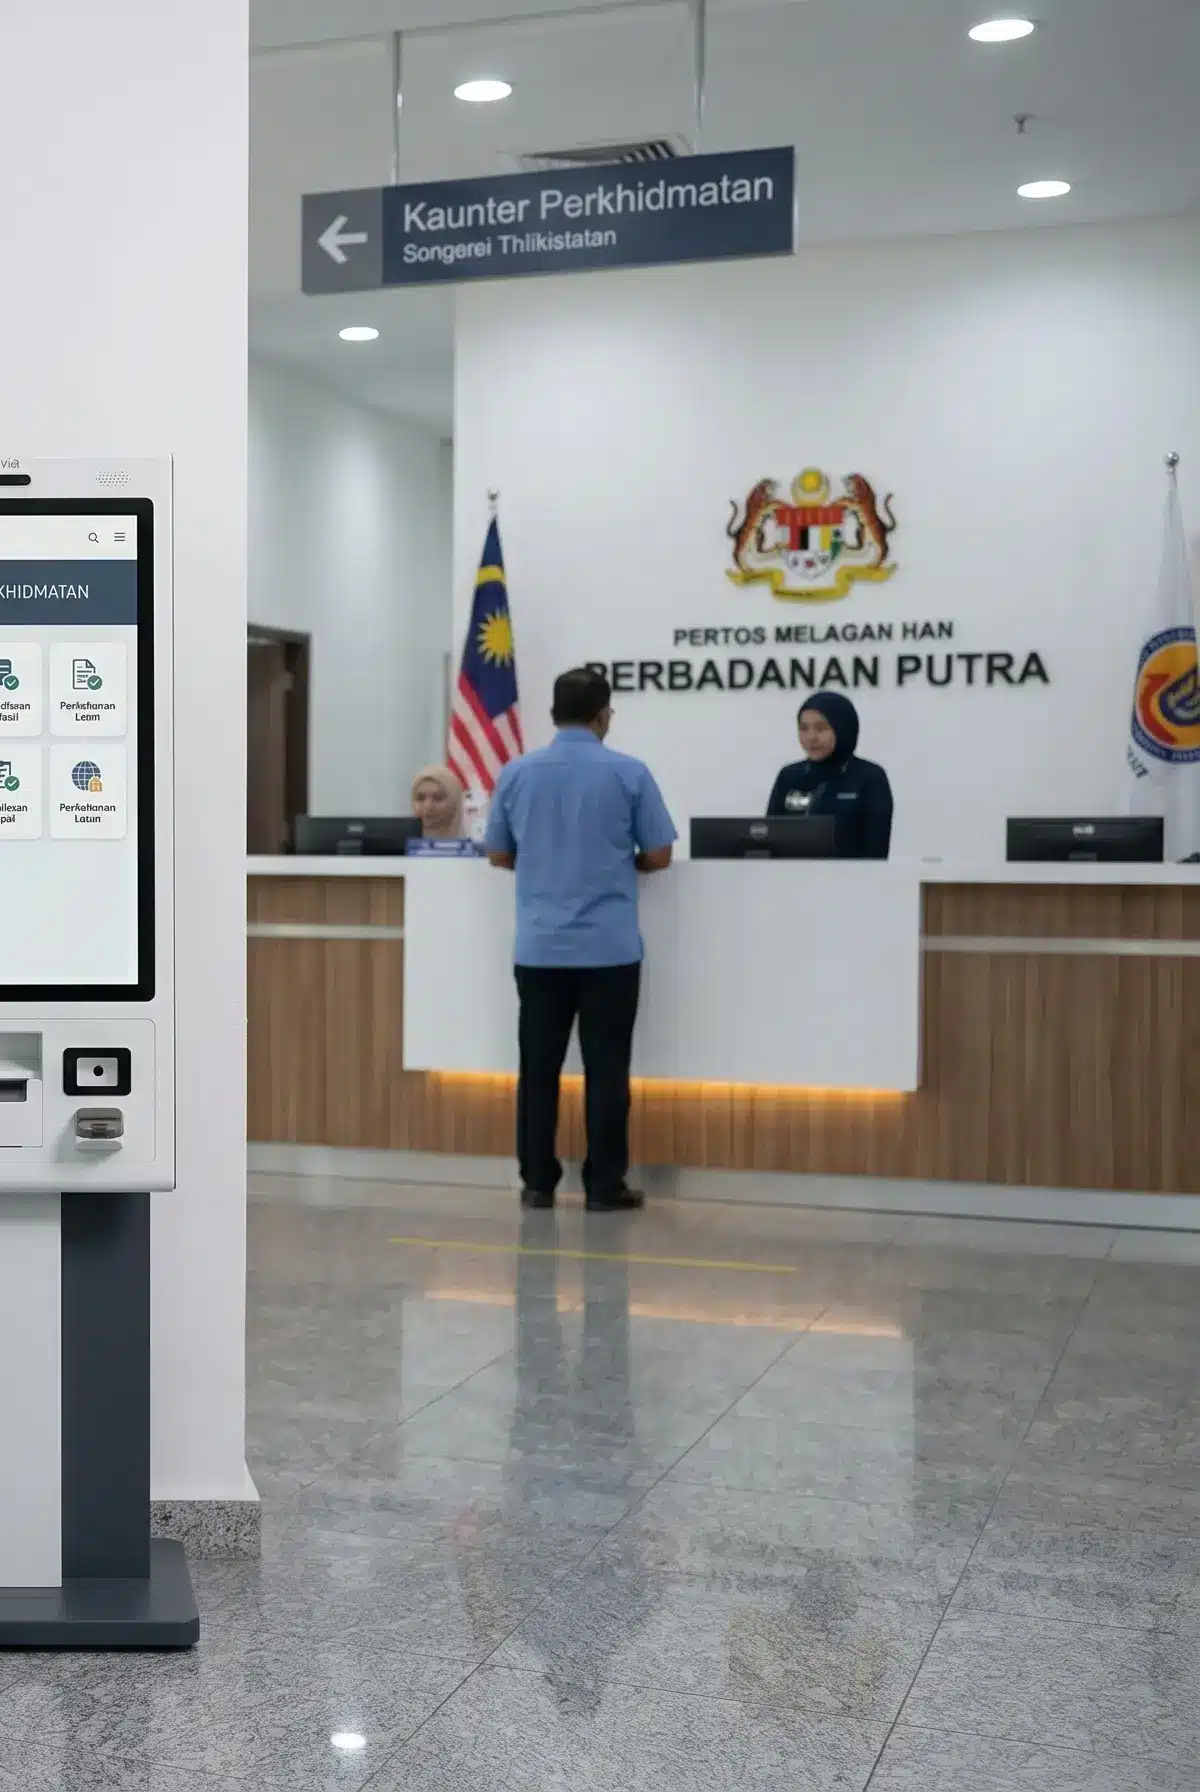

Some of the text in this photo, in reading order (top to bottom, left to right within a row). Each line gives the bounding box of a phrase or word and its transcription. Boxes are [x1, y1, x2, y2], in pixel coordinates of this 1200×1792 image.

[404, 173, 774, 232] Kaunter Perkhidmatan
[403, 236, 492, 265] Songerei
[673, 621, 954, 647] PERTOS MELAGAN HAN
[896, 651, 1050, 687] PUTRA
